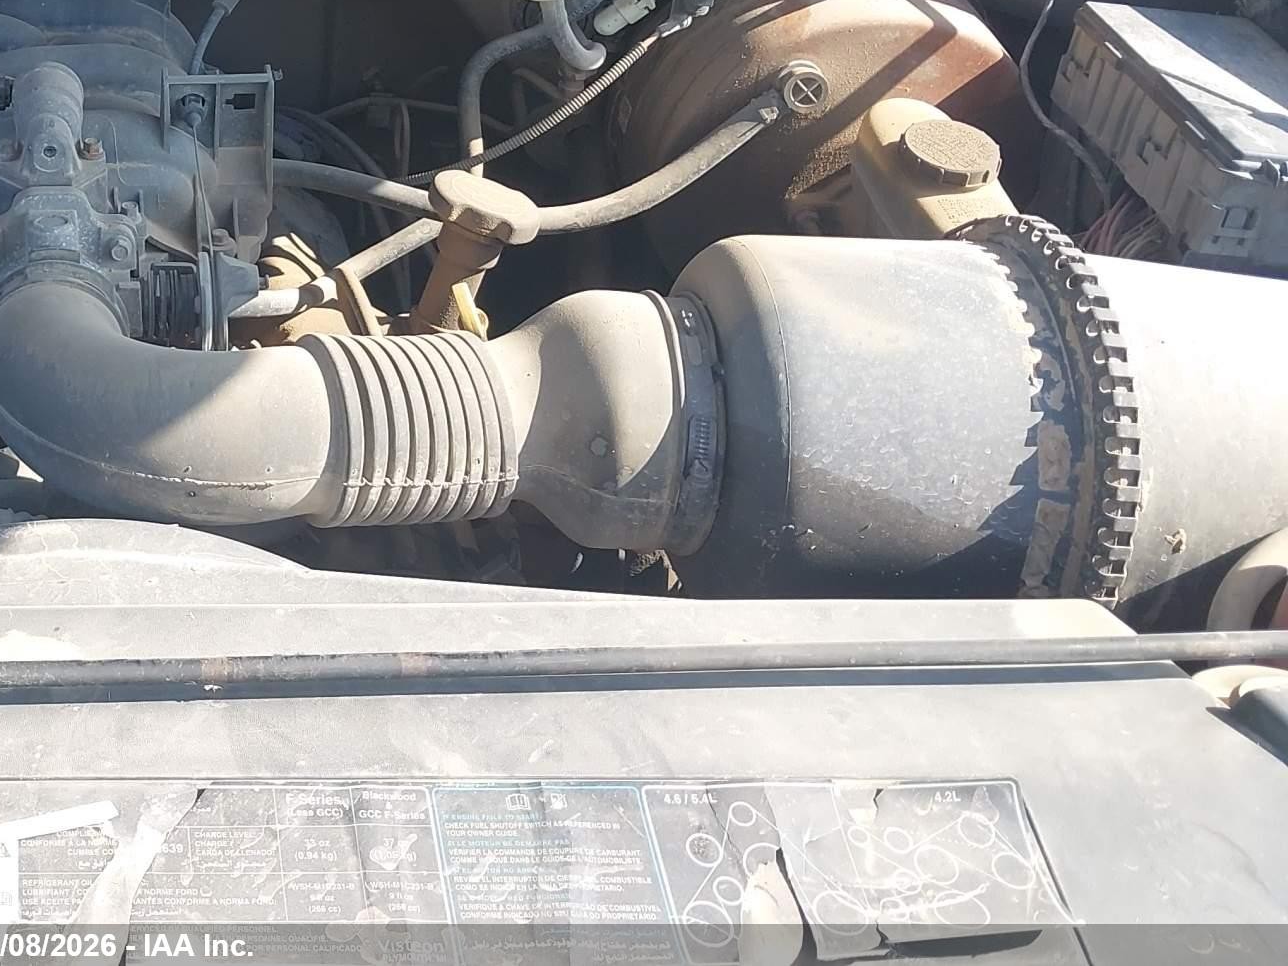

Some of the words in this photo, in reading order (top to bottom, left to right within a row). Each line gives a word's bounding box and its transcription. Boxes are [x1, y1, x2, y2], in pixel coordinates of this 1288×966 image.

[664, 794, 682, 804] 4.6
[935, 790, 961, 802] 4.2L
[317, 808, 344, 818] GCC)
[359, 809, 381, 819] GCC
[162, 844, 183, 854] 639
